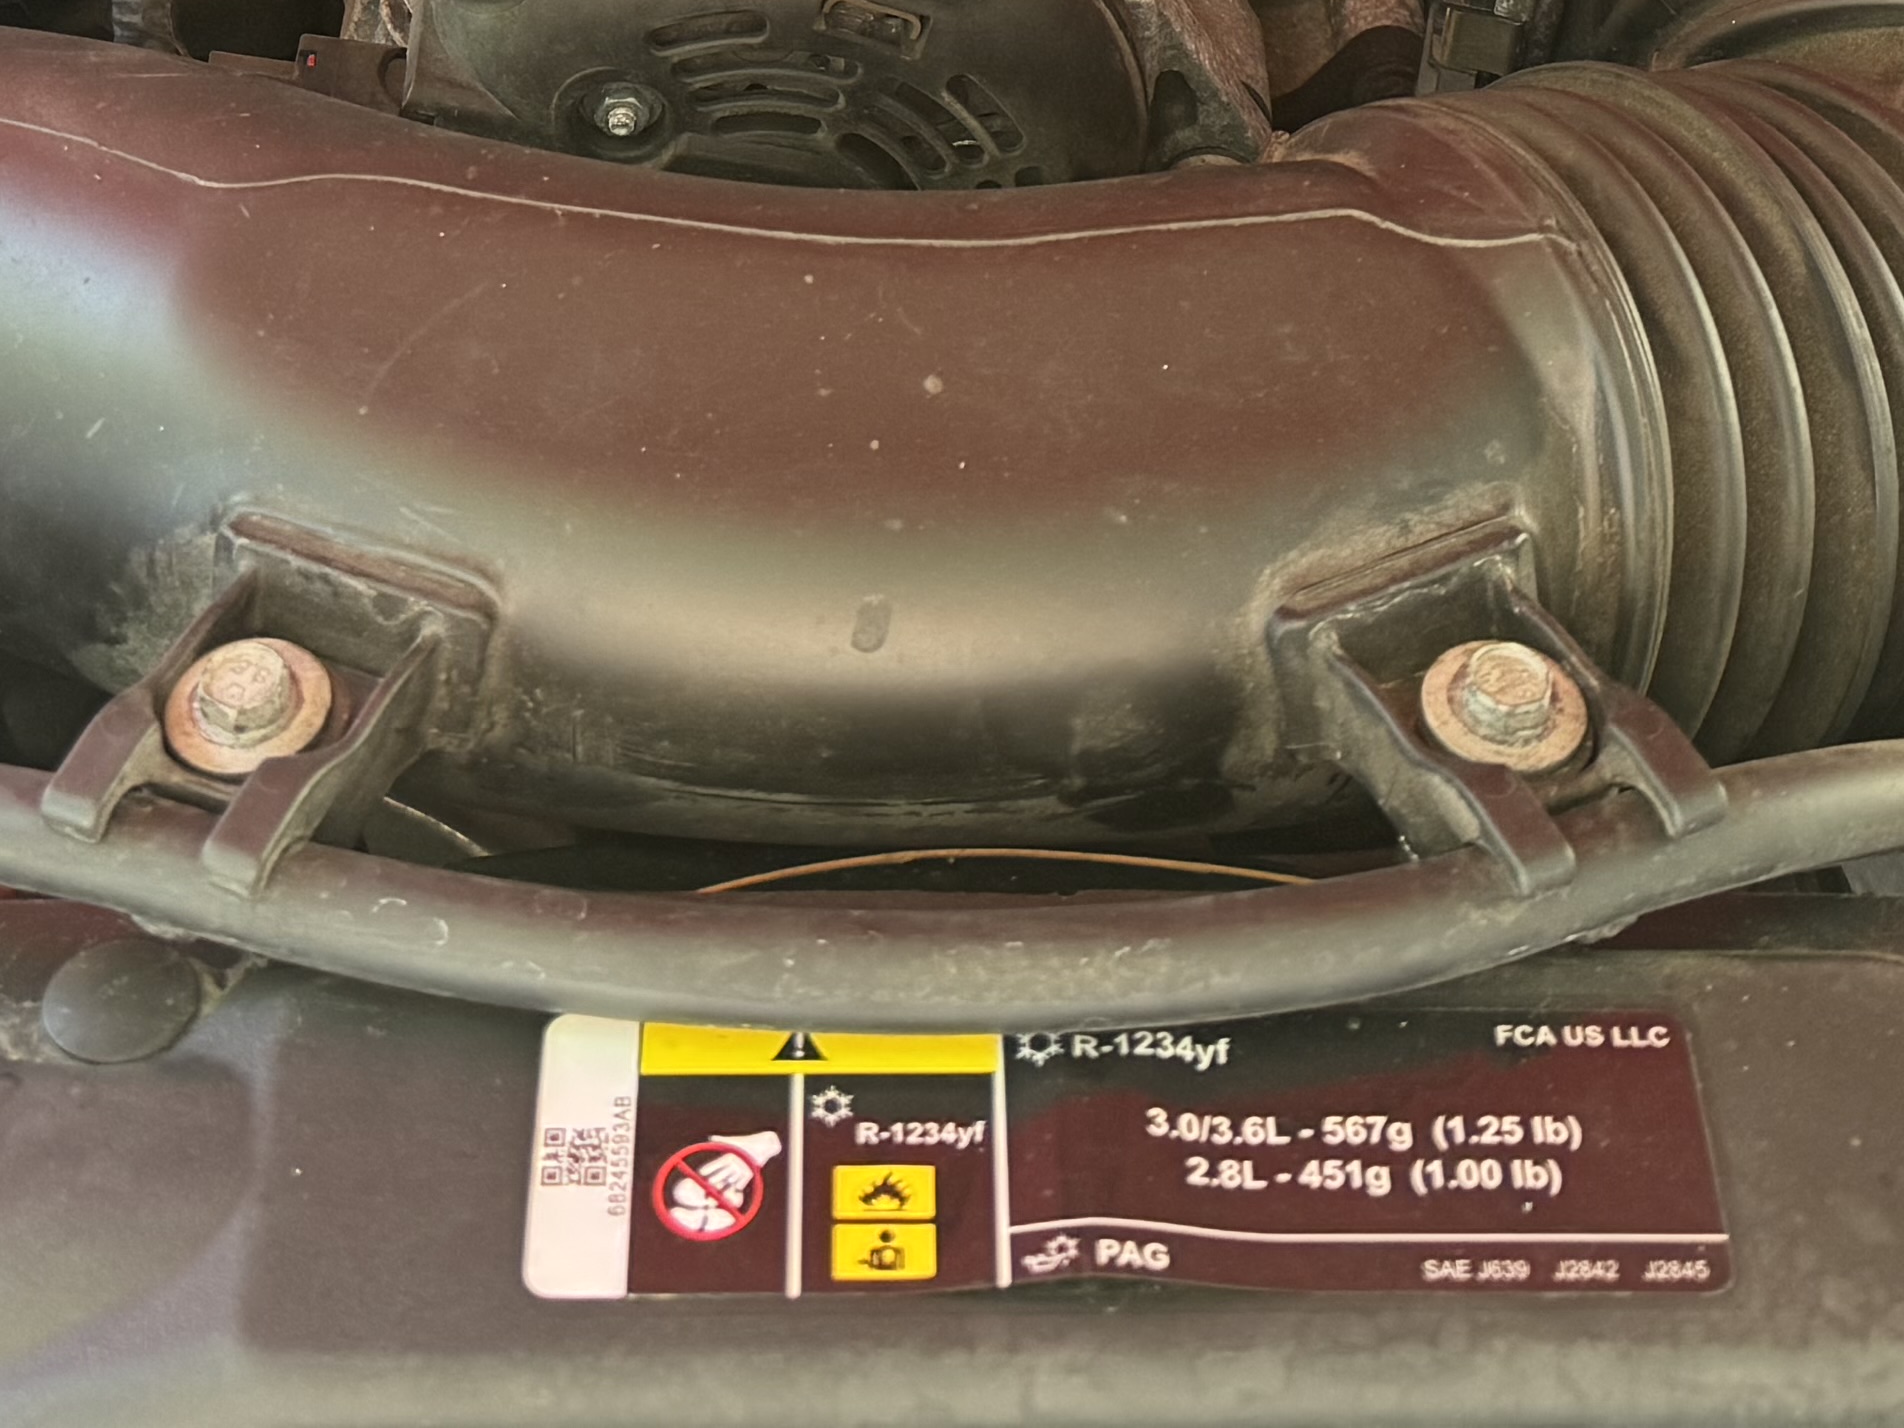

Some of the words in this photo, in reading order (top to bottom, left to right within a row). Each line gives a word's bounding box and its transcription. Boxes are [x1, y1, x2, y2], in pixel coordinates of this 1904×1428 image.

[1072, 1032, 1229, 1073] R-1234yf
[1494, 1024, 1559, 1049] FCA
[1562, 1025, 1605, 1049] US
[1612, 1026, 1671, 1049] LLC
[855, 1121, 986, 1150] R-1234yf
[1145, 1106, 1290, 1147] 3.0/3.6L
[1321, 1116, 1412, 1150] 567g
[1432, 1114, 1524, 1150] (1.25
[1533, 1114, 1583, 1150] lb)
[1185, 1157, 1268, 1189] 2.8L
[1297, 1160, 1391, 1197] 451g
[1410, 1159, 1503, 1196] (1.00
[1512, 1159, 1563, 1196] lb)
[1094, 1238, 1171, 1271] PAG
[1422, 1259, 1471, 1280] SAE
[1477, 1259, 1531, 1281] J639
[1553, 1259, 1622, 1281] J2842
